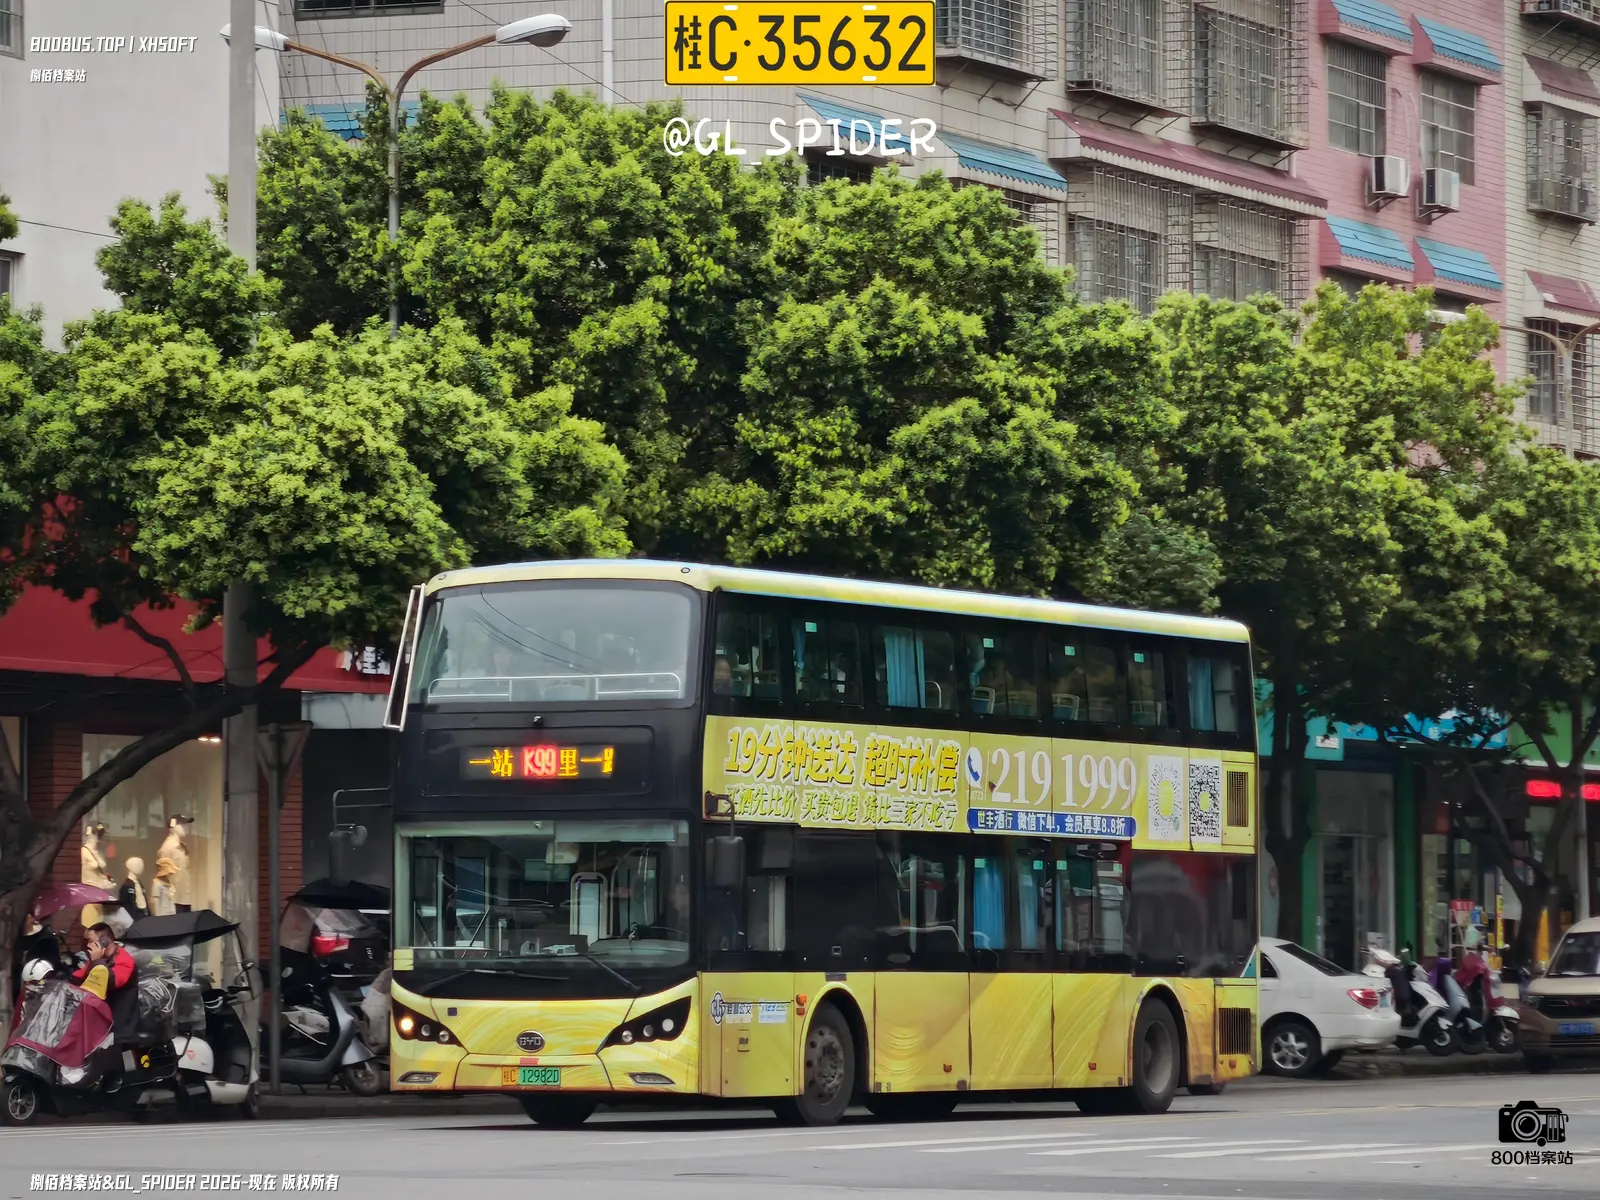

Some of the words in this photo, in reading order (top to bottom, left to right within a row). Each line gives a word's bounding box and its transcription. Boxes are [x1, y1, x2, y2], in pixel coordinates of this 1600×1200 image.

[523, 747, 557, 777] K99
[725, 725, 859, 786] 19分钟送达
[863, 735, 961, 795] 超时补偿
[991, 748, 1051, 806] 219
[1061, 753, 1137, 811] 1999
[519, 1036, 542, 1046] BYD
